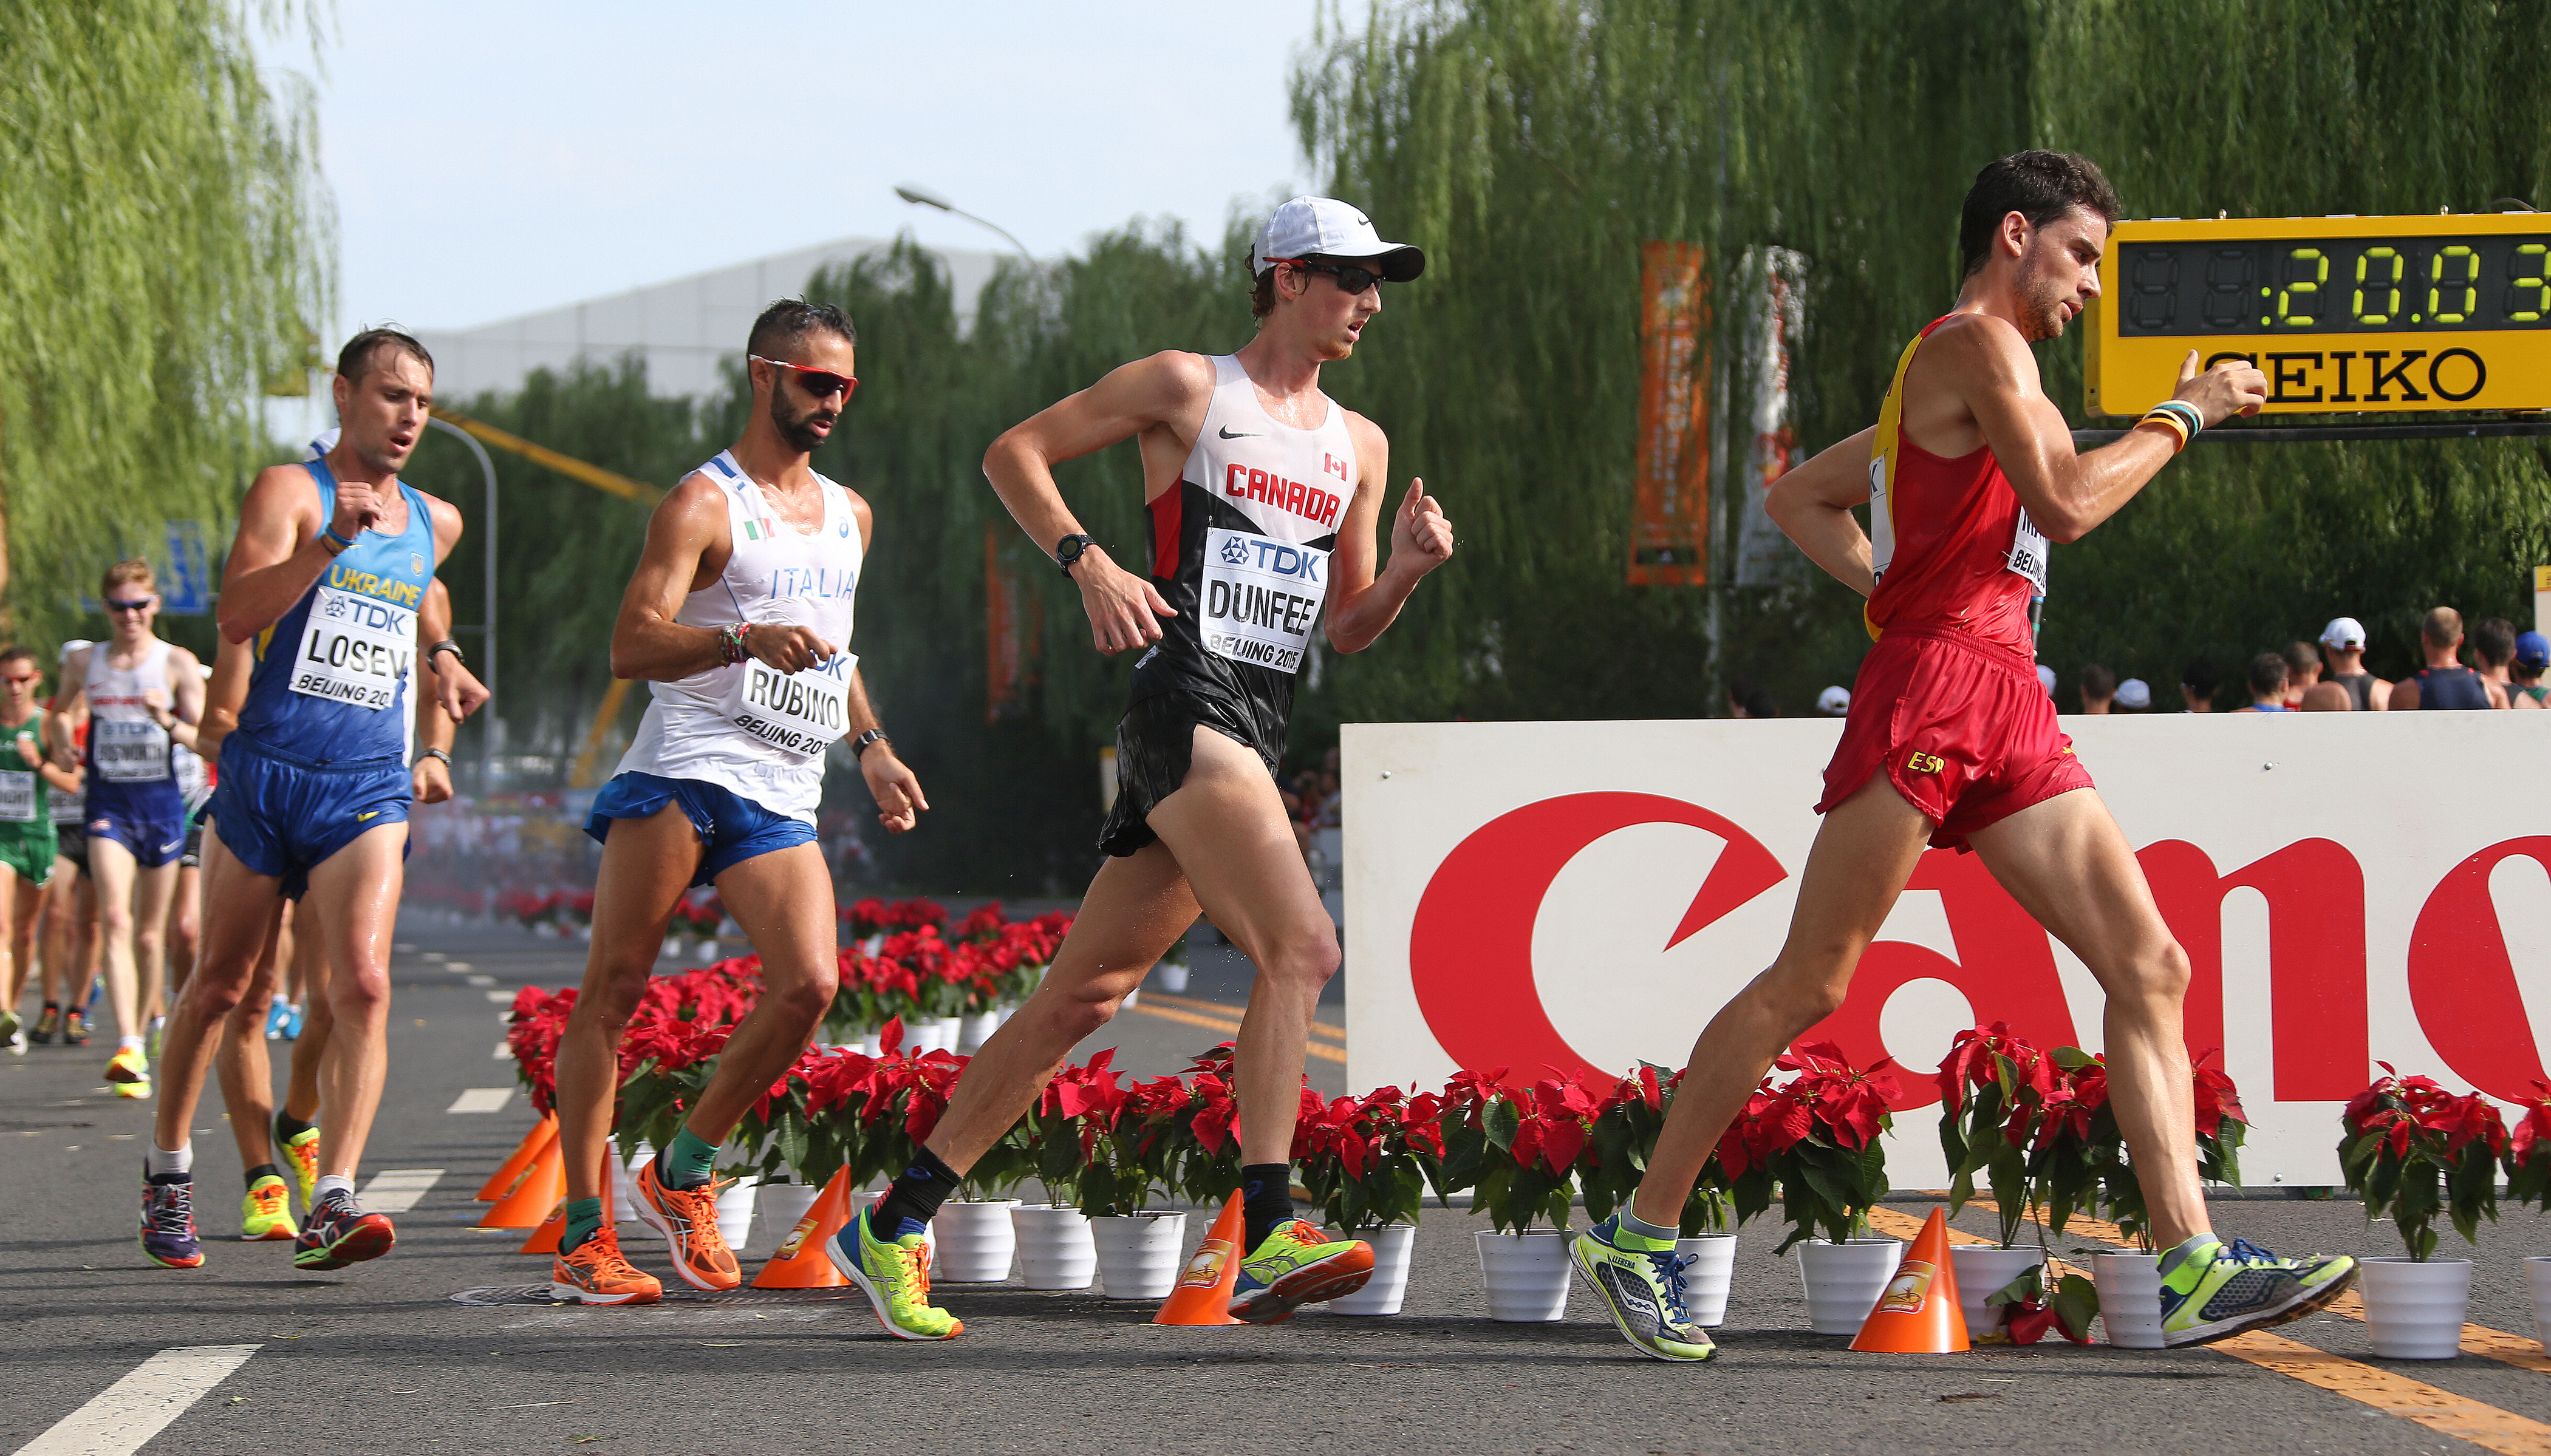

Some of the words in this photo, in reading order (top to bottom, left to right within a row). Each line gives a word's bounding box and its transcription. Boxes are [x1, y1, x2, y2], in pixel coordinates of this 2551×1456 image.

[1226, 463, 1341, 528] CANADA
[1250, 539, 1320, 582] TDK
[2013, 549, 2043, 582] BEIJING
[330, 564, 422, 607] UKRAINE
[770, 566, 856, 600] ITALIA
[348, 597, 406, 636] TDK
[1208, 579, 1316, 636] DUNFEE
[307, 628, 408, 679] LOSEV
[1210, 633, 1275, 663] BEIJING
[296, 673, 367, 701] BEIJING
[750, 670, 839, 730] RUBINO
[733, 714, 802, 747] BEIJING
[1907, 750, 1945, 775] ESP
[1612, 1255, 1636, 1270] LLERENA
